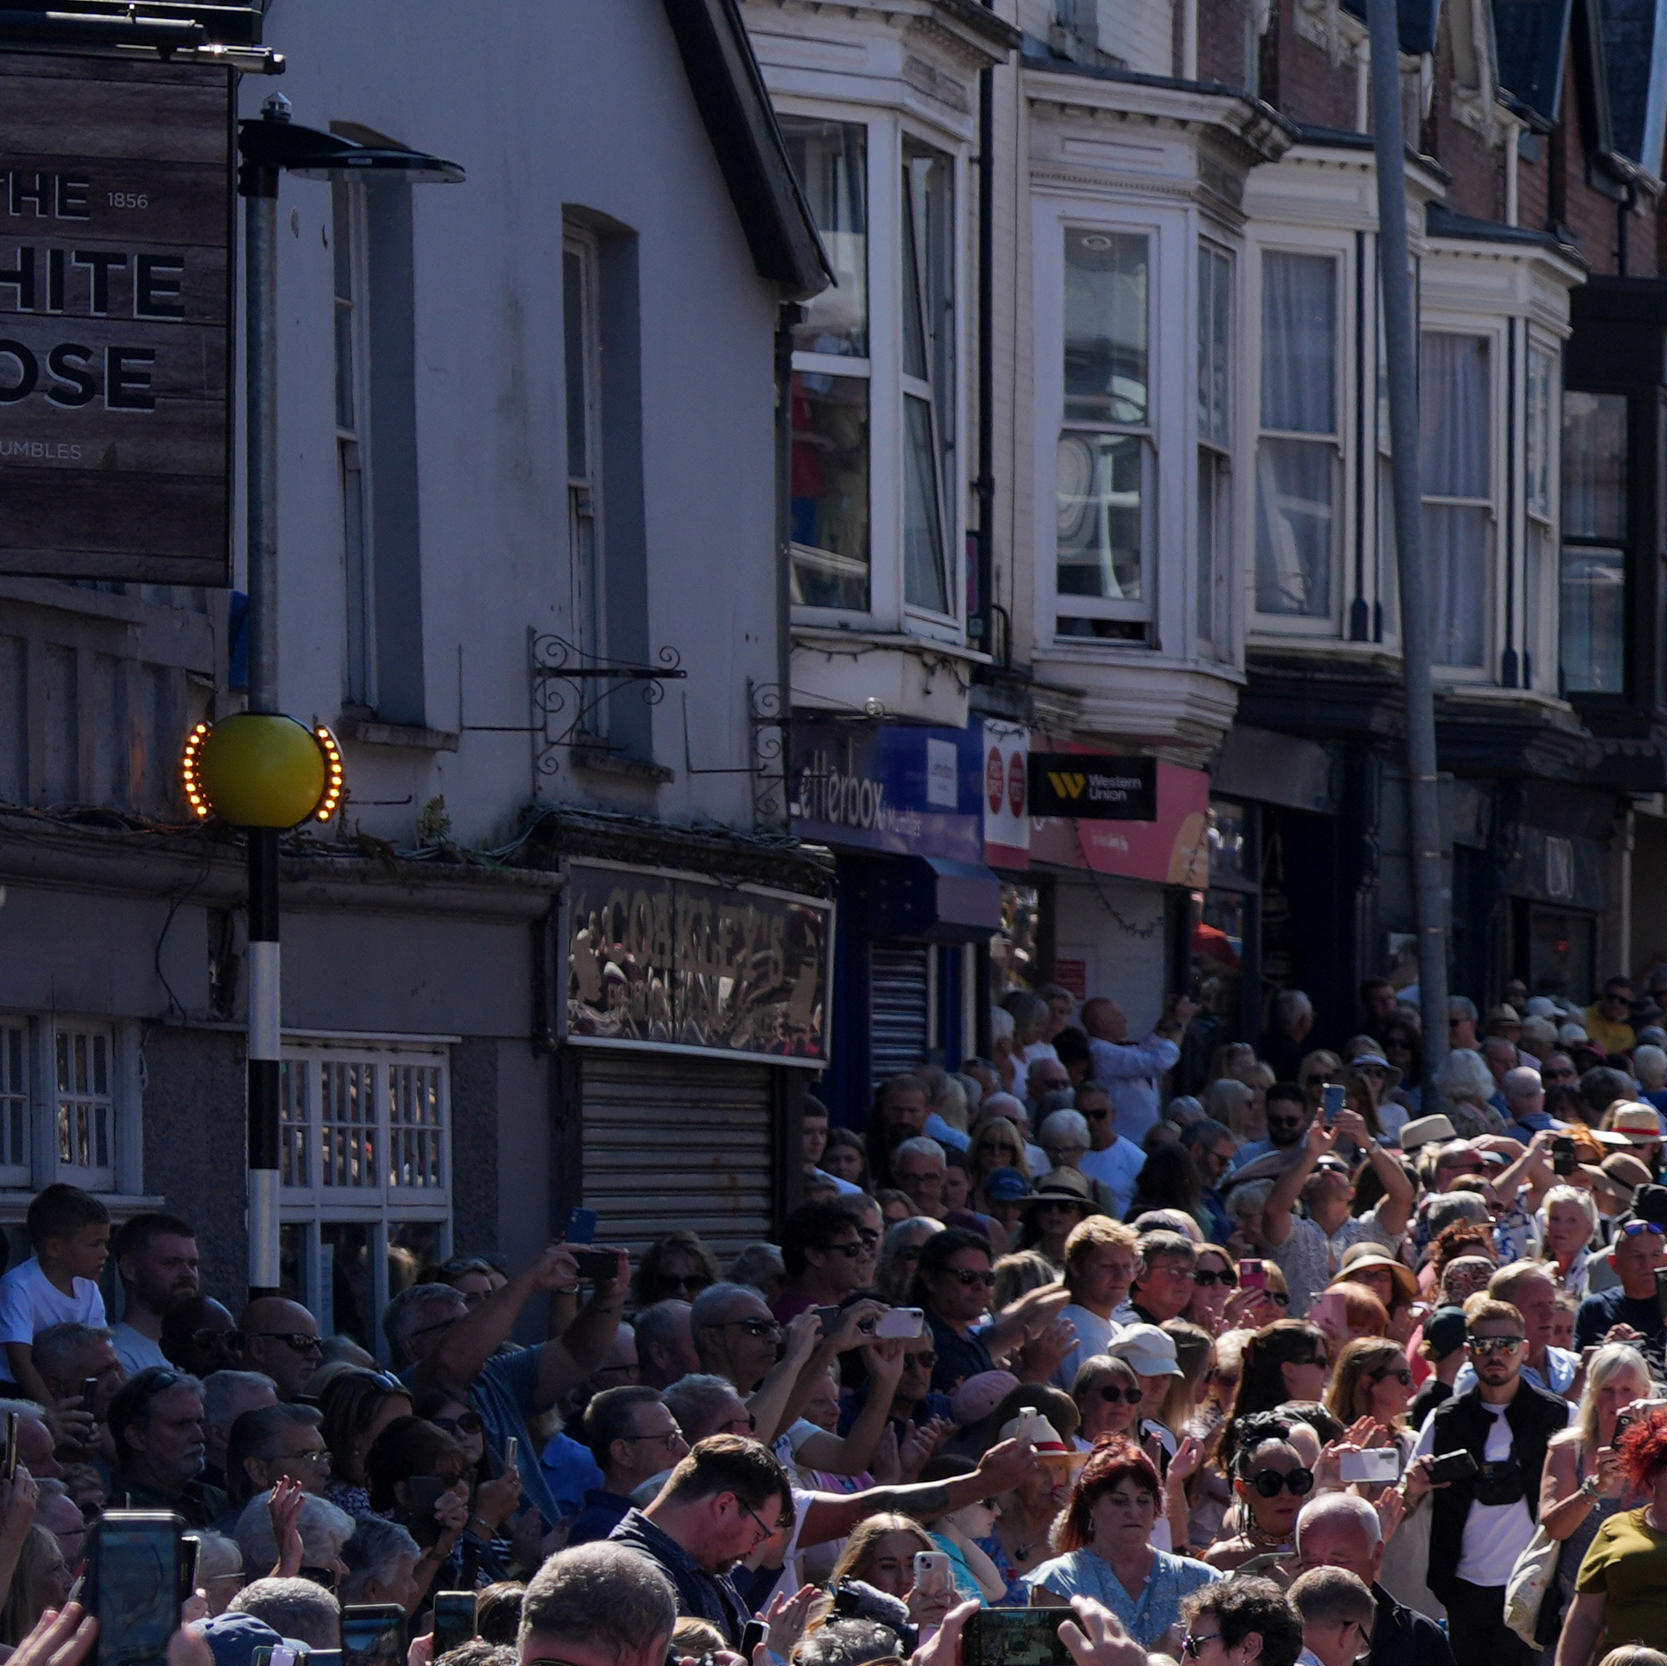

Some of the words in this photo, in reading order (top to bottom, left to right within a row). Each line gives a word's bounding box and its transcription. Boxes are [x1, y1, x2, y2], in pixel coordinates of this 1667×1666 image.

[0, 171, 90, 220] HE
[107, 192, 149, 209] 1856
[1089, 774, 1143, 790] Western
[1089, 787, 1128, 801] Union
